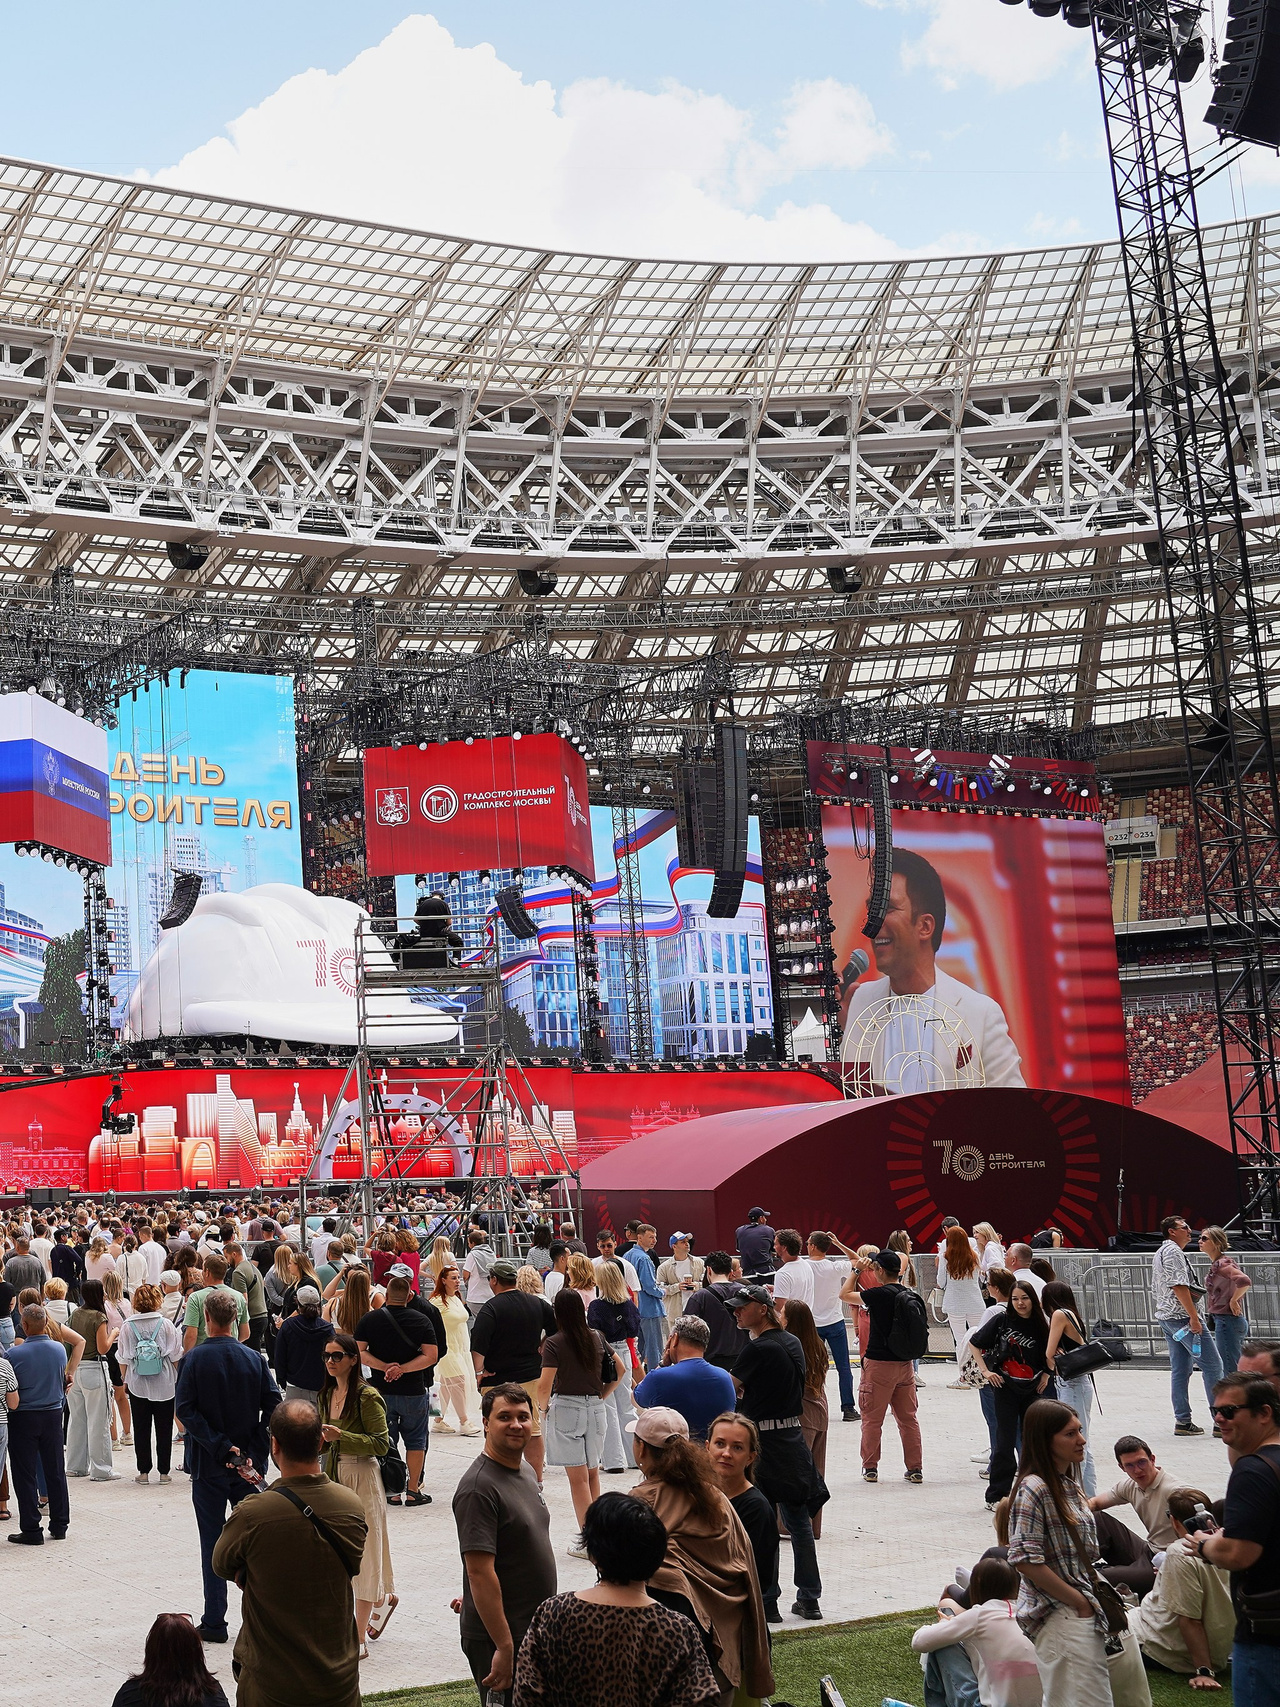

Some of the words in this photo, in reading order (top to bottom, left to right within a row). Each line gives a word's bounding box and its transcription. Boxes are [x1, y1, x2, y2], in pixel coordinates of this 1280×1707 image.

[110, 752, 225, 786] ДЕНЬ
[463, 786, 555, 800] ГРАДОСТРОИТЕЛЬНЫЙ
[109, 792, 292, 829] РОИТЕЛЯ
[463, 800, 511, 810] КОМПЛЕКС
[513, 797, 551, 807] МОСКВЫ
[989, 1161, 1046, 1170] СТРОИТЕЛЯ
